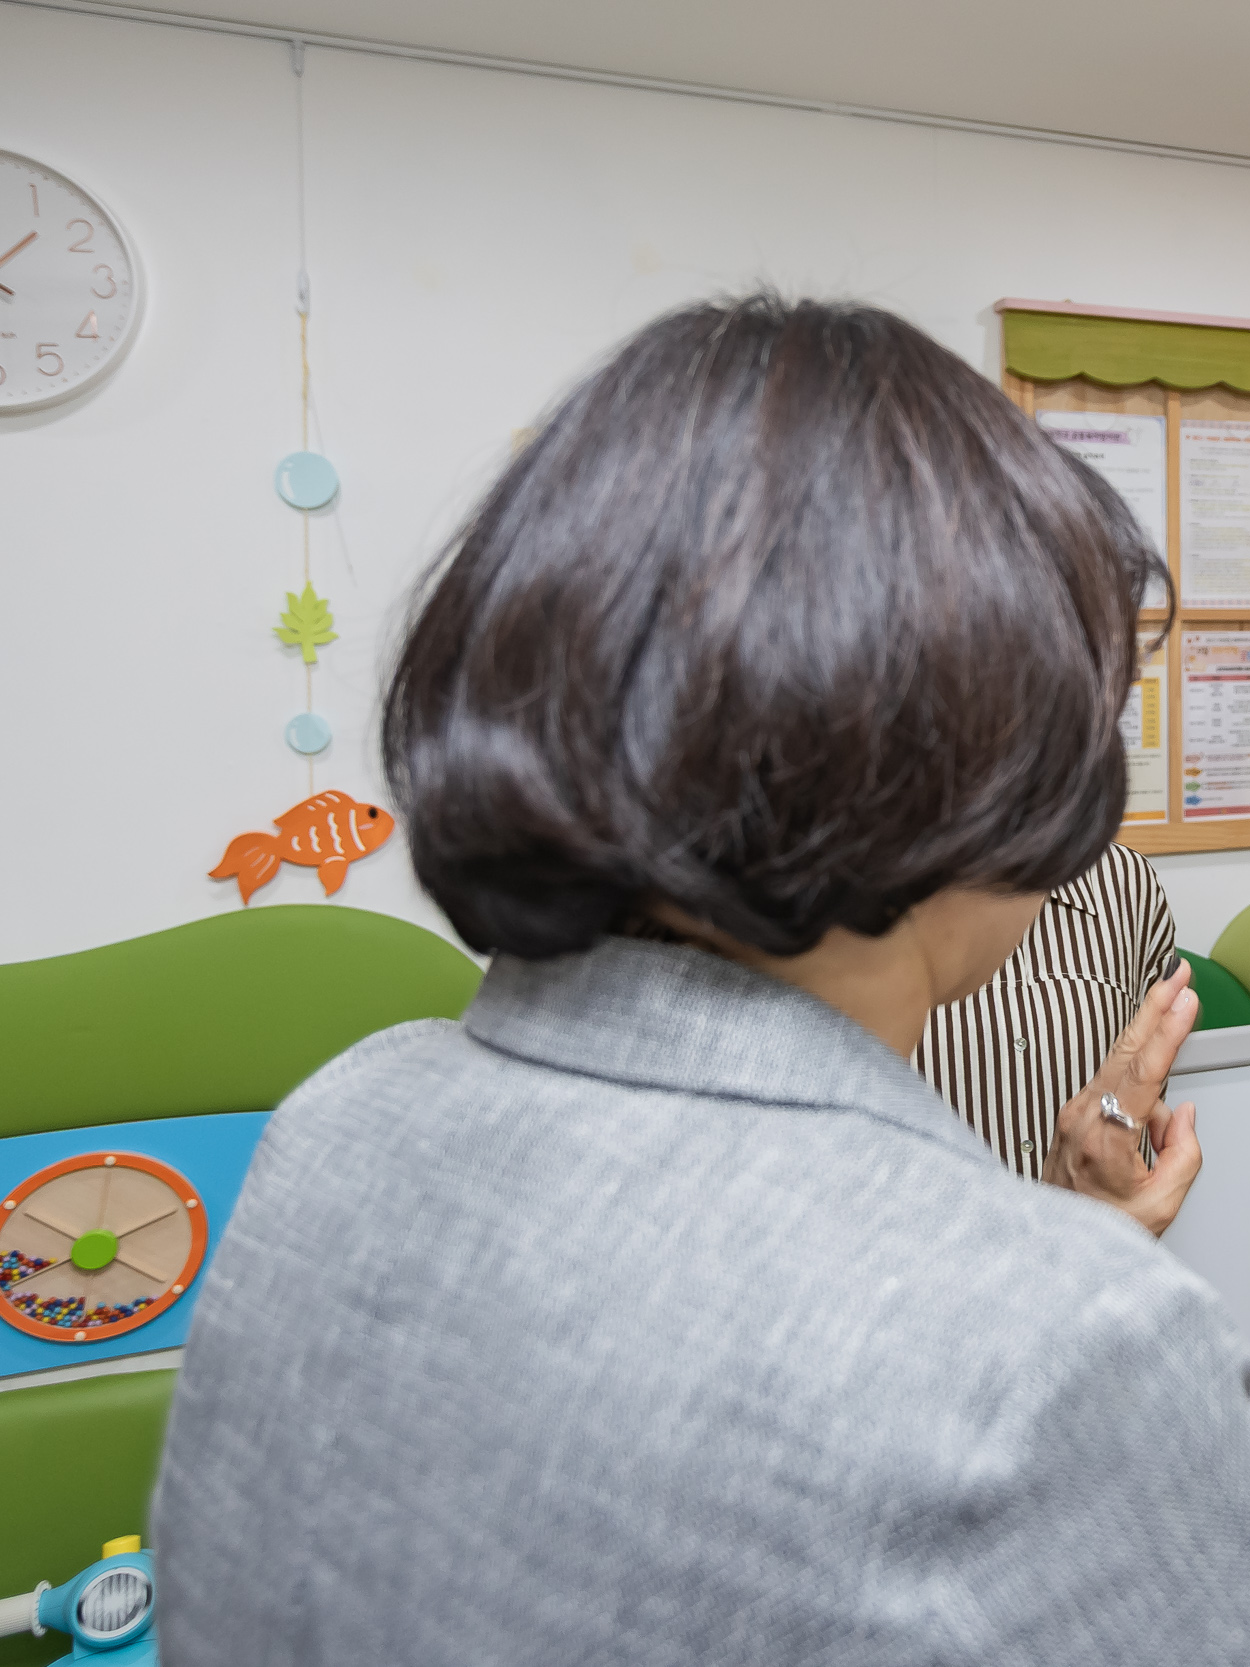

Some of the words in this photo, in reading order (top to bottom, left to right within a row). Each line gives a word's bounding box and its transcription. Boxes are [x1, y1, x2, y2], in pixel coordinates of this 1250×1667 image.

[29, 183, 40, 217] 1
[66, 217, 95, 253] 2
[91, 263, 117, 299] 3
[75, 309, 101, 340] 4
[36, 343, 64, 376] 5
